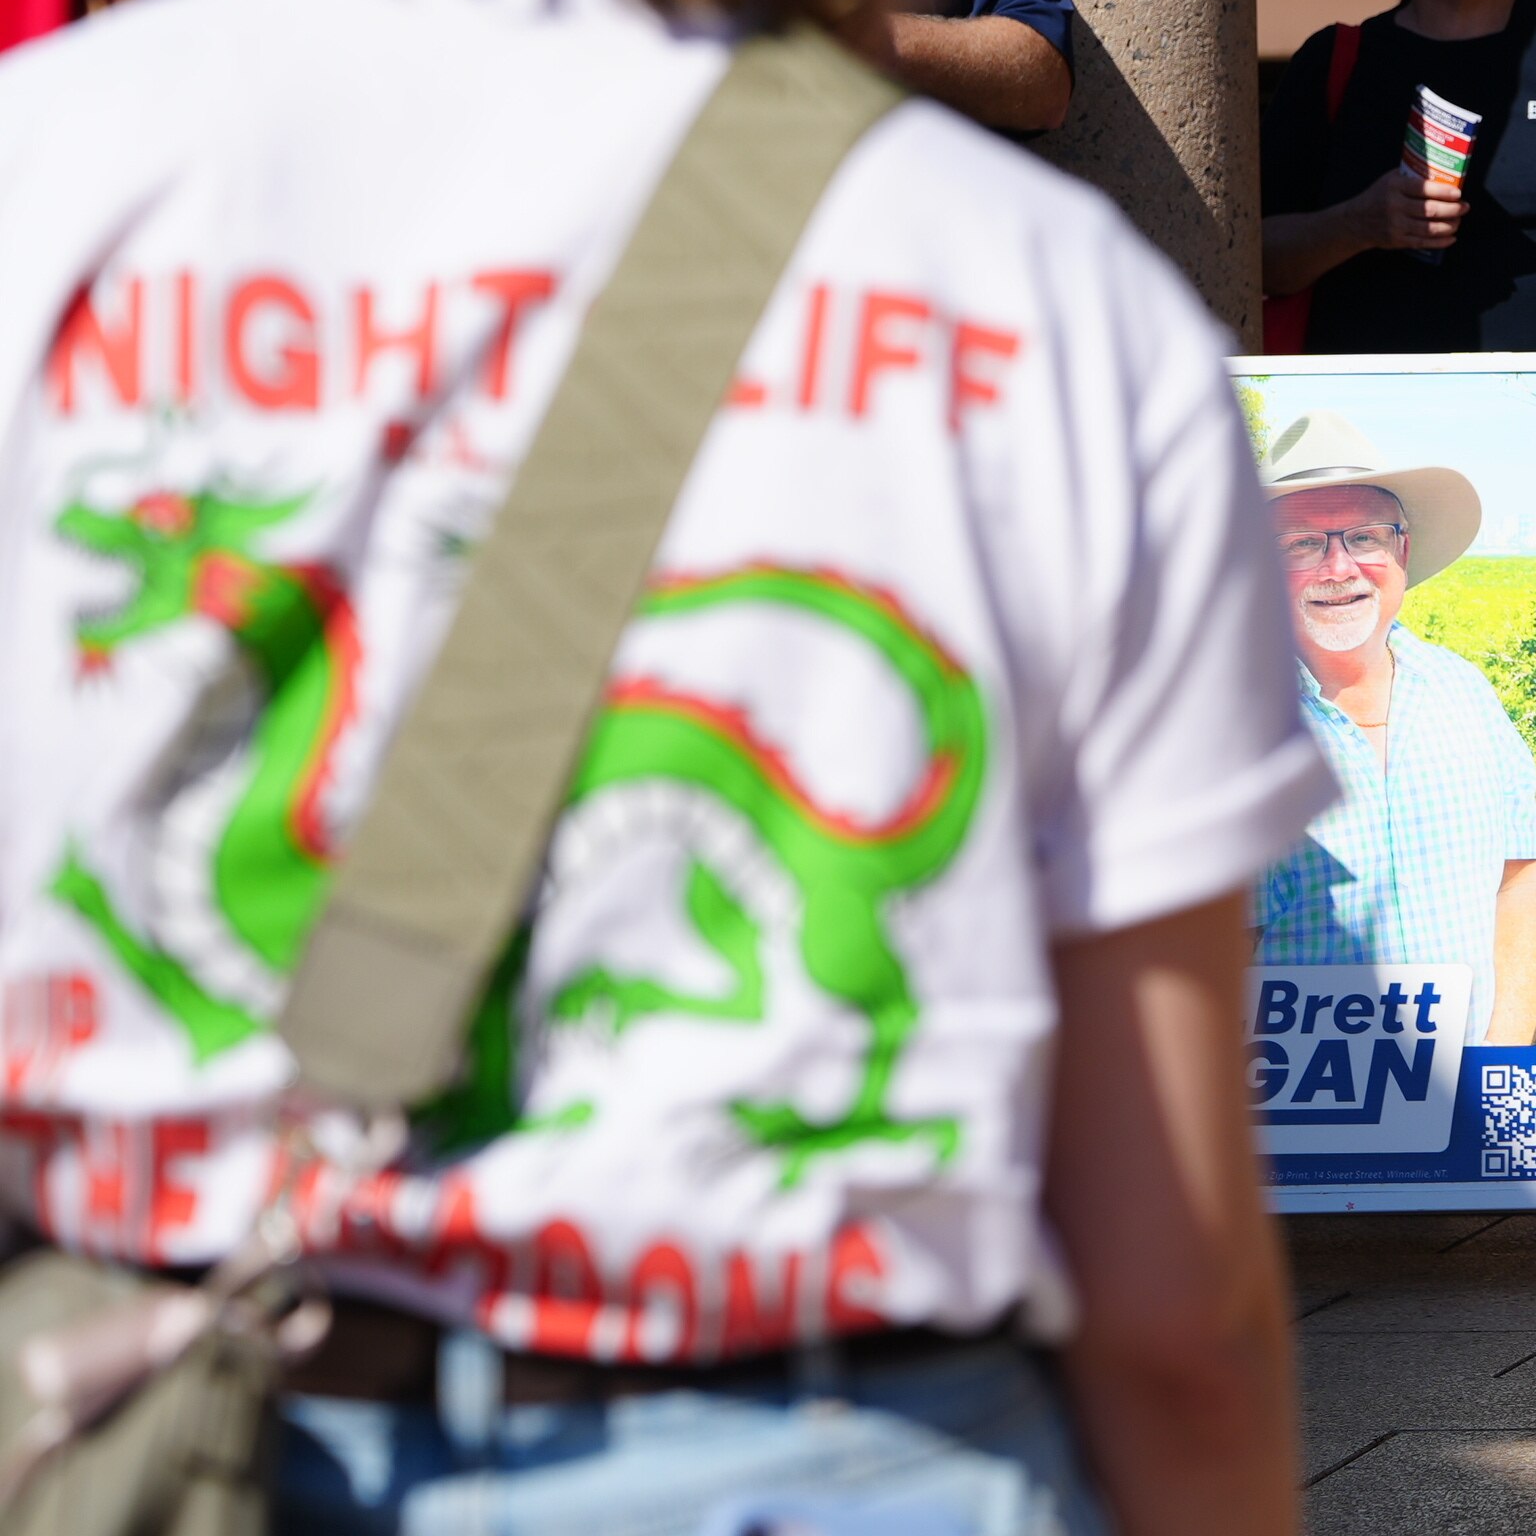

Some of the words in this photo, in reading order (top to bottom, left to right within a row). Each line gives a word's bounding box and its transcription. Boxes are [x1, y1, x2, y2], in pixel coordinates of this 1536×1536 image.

[1253, 980, 1442, 1035] Brett
[1240, 1038, 1437, 1106] GAN
[1326, 1170, 1353, 1180] Sweet
